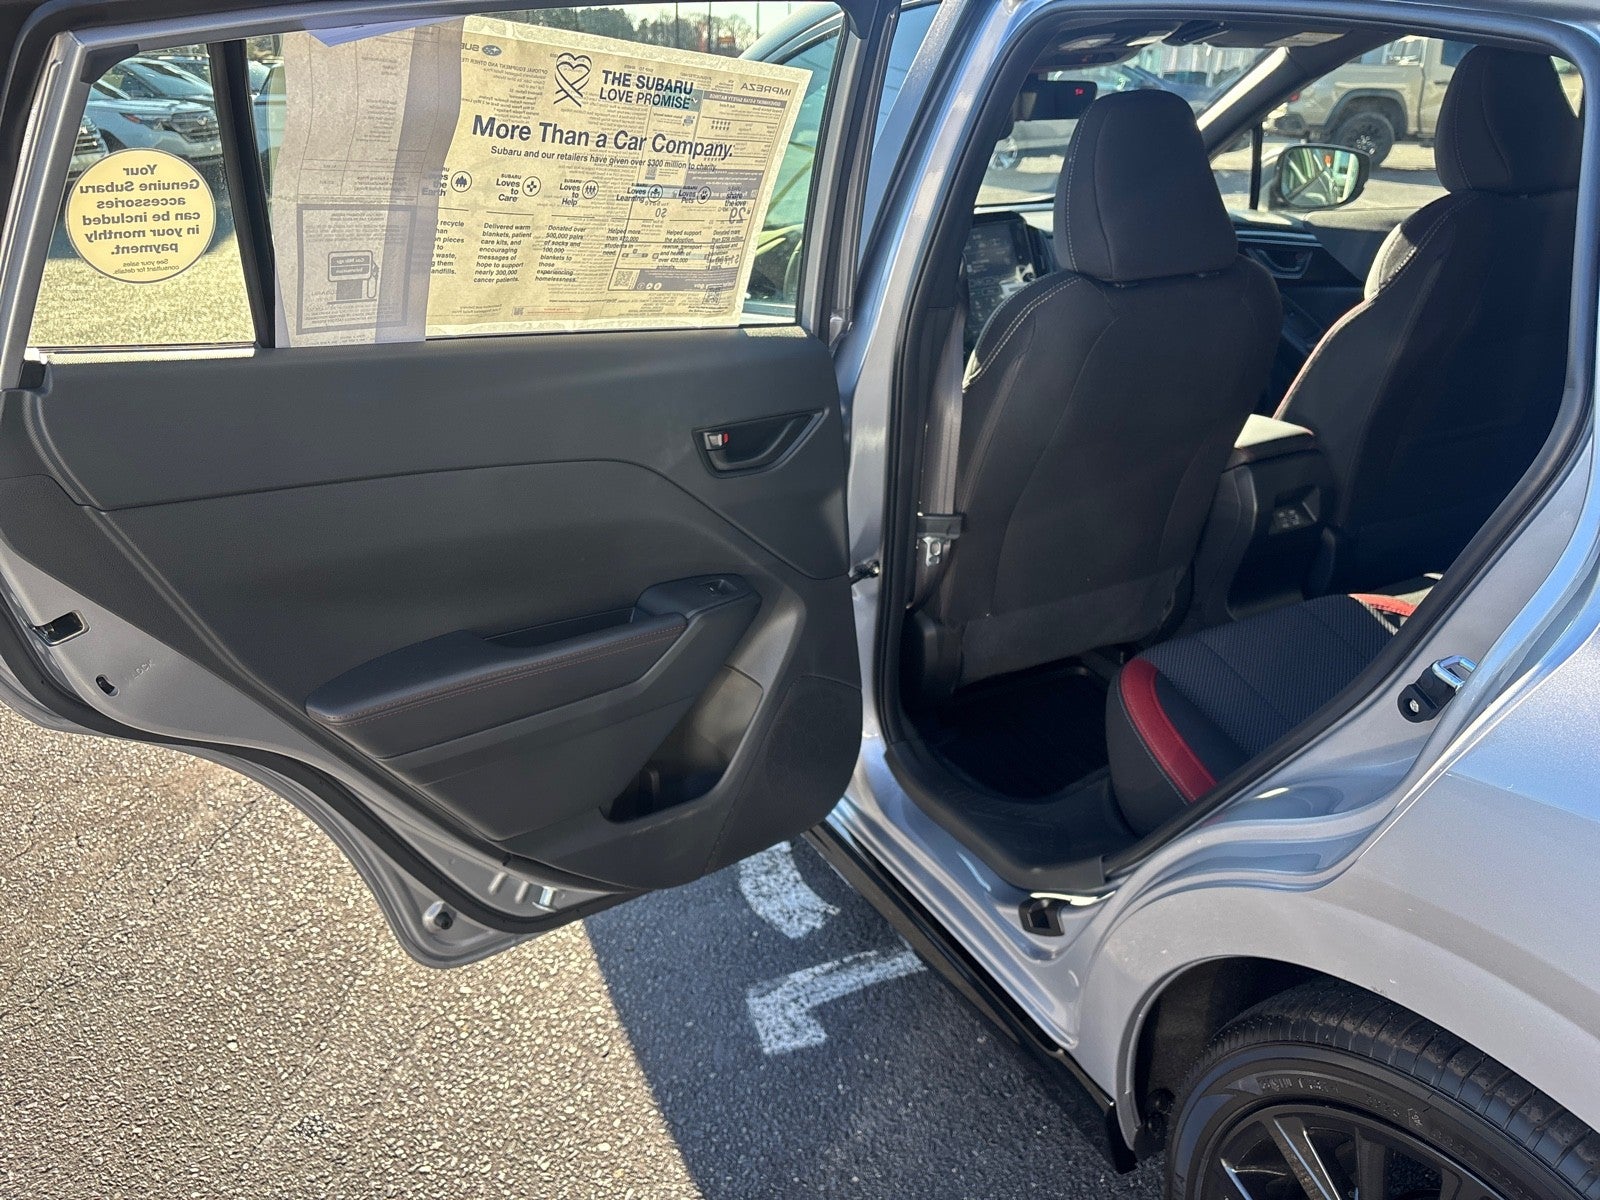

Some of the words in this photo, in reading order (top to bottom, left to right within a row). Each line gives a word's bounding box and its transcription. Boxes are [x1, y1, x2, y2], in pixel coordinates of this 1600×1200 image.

[602, 70, 632, 88] THE
[635, 75, 694, 95] SUBARU
[600, 87, 634, 103] LOVE
[636, 92, 691, 110] PROMISE
[472, 115, 532, 141] More
[539, 122, 590, 147] Than
[596, 132, 607, 148] a
[614, 130, 647, 151] Car
[652, 133, 733, 161] Company.
[491, 146, 522, 157] Subaru
[524, 150, 540, 158] and
[557, 153, 588, 162] retailers
[590, 155, 608, 163] have
[609, 157, 629, 167] given
[647, 159, 664, 167] $300
[665, 160, 687, 169] million
[496, 178, 520, 187] Loves
[560, 183, 580, 191] Loves
[627, 187, 646, 195] Loves
[498, 194, 518, 202] Care
[562, 198, 578, 207] Help
